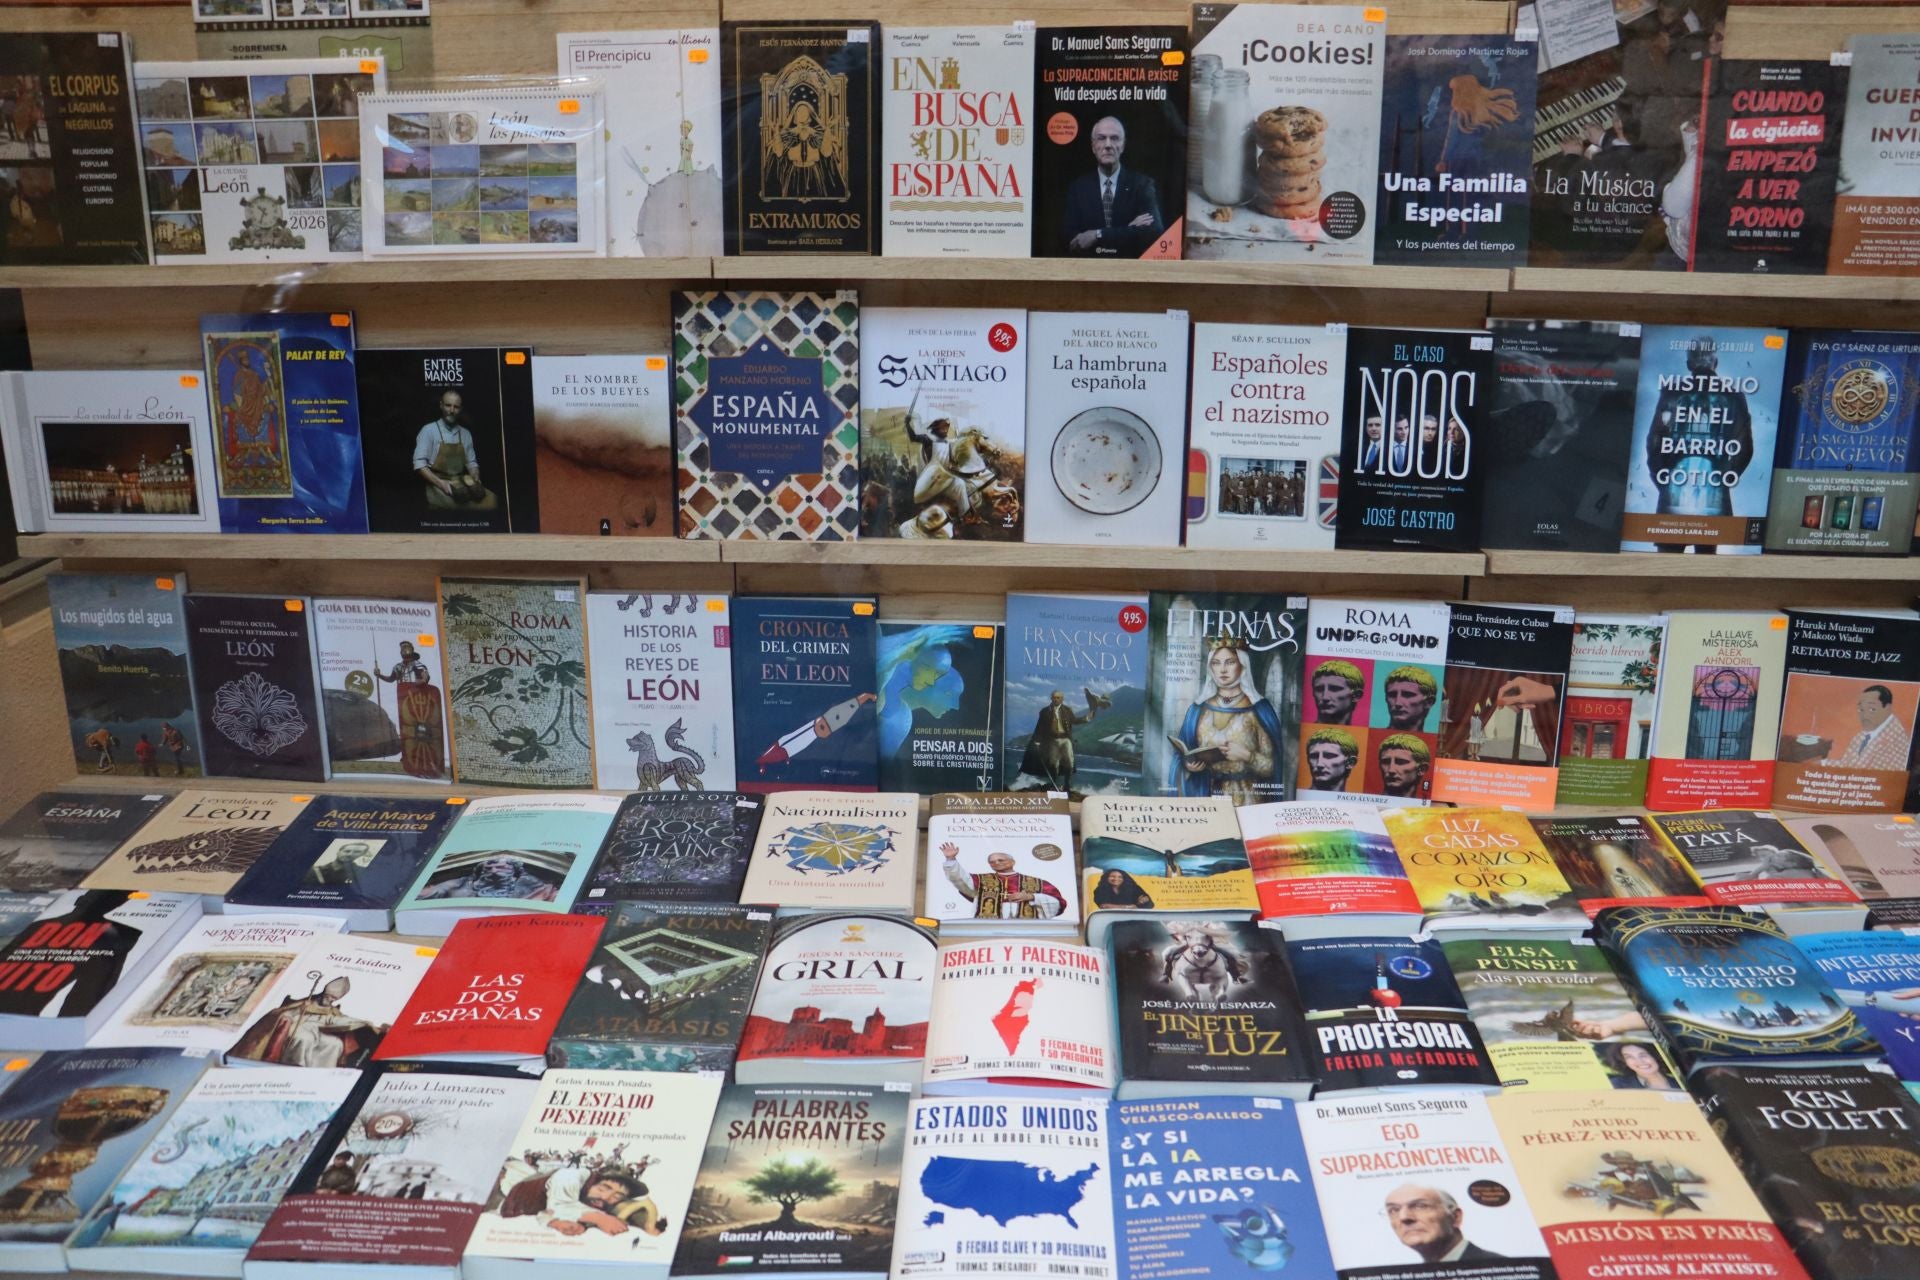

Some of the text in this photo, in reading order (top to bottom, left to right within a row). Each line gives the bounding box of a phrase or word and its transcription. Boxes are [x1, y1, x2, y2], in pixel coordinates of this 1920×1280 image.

[1052, 35, 1172, 52] Dr. Manuel Sans Segarra
[1242, 39, 1374, 66] ¡Cookies!
[1408, 47, 1528, 58] José Domingo Martínez Rojas
[575, 50, 651, 65] El Prencipicu
[890, 56, 940, 91] EN
[50, 75, 119, 96] EL CORPUS
[912, 92, 1024, 127] BUSCA
[1732, 90, 1824, 113] CUANDO
[65, 119, 113, 131] NEGRILLOS
[1729, 120, 1821, 144] la cigüeña
[934, 128, 981, 162] DE
[1727, 147, 1817, 172] EMPEZÓ
[202, 168, 250, 194] León
[890, 156, 1022, 198] ESPAÑA
[1384, 173, 1527, 193] Una Familia
[1545, 170, 1655, 198] La Música
[1738, 179, 1800, 200] A VER
[290, 216, 326, 230] 2026
[749, 213, 861, 229] EXTRAMUROS
[1405, 202, 1503, 227] Especial
[1728, 206, 1805, 228] PORNO
[286, 350, 346, 361] PALAT DE REY
[424, 358, 462, 371] ENTRE
[1052, 354, 1167, 373] La hambruna
[1211, 351, 1328, 379] Españoles
[424, 369, 463, 382] MANOS
[565, 375, 639, 384] EL NOMBRE
[878, 354, 1007, 388] SANTIAGO
[552, 387, 650, 396] DE LOS BUEYES
[1071, 374, 1146, 392] española
[1230, 380, 1305, 401] contra
[1657, 374, 1759, 395] MISTERIO
[712, 391, 820, 419] ESPAÑA
[1205, 401, 1330, 426] el nazismo
[1353, 363, 1476, 480] NÓOS
[1675, 407, 1733, 424] EN EL
[712, 423, 819, 436] MONUMENTAL
[1660, 438, 1742, 457] BARRIO
[1798, 446, 1906, 463] LONGEVOS
[1656, 465, 1739, 487] GÓTICO
[1362, 507, 1455, 530] JOSÉ CASTRO
[1647, 527, 1683, 535] FERNANDO
[60, 608, 173, 627] Los mugidos del agua
[1346, 608, 1411, 628] ROMA
[624, 625, 698, 638] HISTORIA
[1024, 626, 1132, 649] FRANCISCO
[1316, 627, 1439, 649] UNDERGROUND
[1710, 630, 1752, 639] LA LLAVE
[225, 639, 275, 657] LEÓN
[641, 643, 681, 653] DE LOS
[1703, 639, 1758, 648] MISTERIOSA
[1023, 647, 1131, 672] MIRANDA
[1792, 646, 1901, 664] RETRATOS DE JAZZ
[626, 658, 699, 672] REYES DE
[627, 675, 700, 701] LEÓN
[1570, 704, 1624, 715] LIBROS
[913, 740, 993, 754] PENSAR A DIOS
[45, 805, 122, 819] ESPAÑA
[182, 804, 272, 821] León
[325, 809, 436, 821] Aquel Marvá
[773, 806, 907, 819] Nacionalismo
[315, 819, 429, 831] de Villafranca
[1440, 818, 1486, 833] LUZ
[1675, 828, 1759, 847] TATÁ
[943, 946, 1100, 973] ISRAEL Y PALESTINA
[1489, 946, 1556, 959] ELSA
[772, 960, 923, 982] GRIAL
[1476, 958, 1578, 971] PUNSET
[1664, 961, 1798, 978] EL ÚLTIMO
[468, 974, 524, 988] LAS
[1474, 972, 1598, 987] Alas para volar
[1683, 975, 1795, 989] SECRETO
[456, 990, 519, 1005] DOS
[415, 1005, 543, 1025] ESPAÑAS
[1376, 1007, 1398, 1022] LA
[1317, 1022, 1473, 1054] PROFESORA
[1324, 1052, 1479, 1072] FREIDA McFADDEN
[548, 1090, 654, 1109] EL ESTADO
[1783, 1090, 1856, 1108] KEN
[540, 1108, 632, 1127] PESEBRE
[751, 1099, 870, 1119] PALABRAS
[915, 1105, 1098, 1132] ESTADOS UNIDOS
[1758, 1106, 1911, 1130] FOLLETT
[728, 1120, 886, 1142] SANGRANTES
[913, 1133, 1099, 1147] UN PAÍS AL BORDE DEL CAOS
[1121, 1130, 1188, 1150] ¿Y SI
[1381, 1123, 1419, 1141] EGO
[1123, 1149, 1201, 1167] LA IA
[1320, 1146, 1503, 1176] SUPRACONCIENCIA
[1124, 1167, 1301, 1187] ME ARREGLA
[1126, 1187, 1254, 1209] LA VIDA?
[719, 1230, 835, 1243] Ramzi Albayrouti
[1553, 1222, 1775, 1246] MISIÓN EN PARÍS
